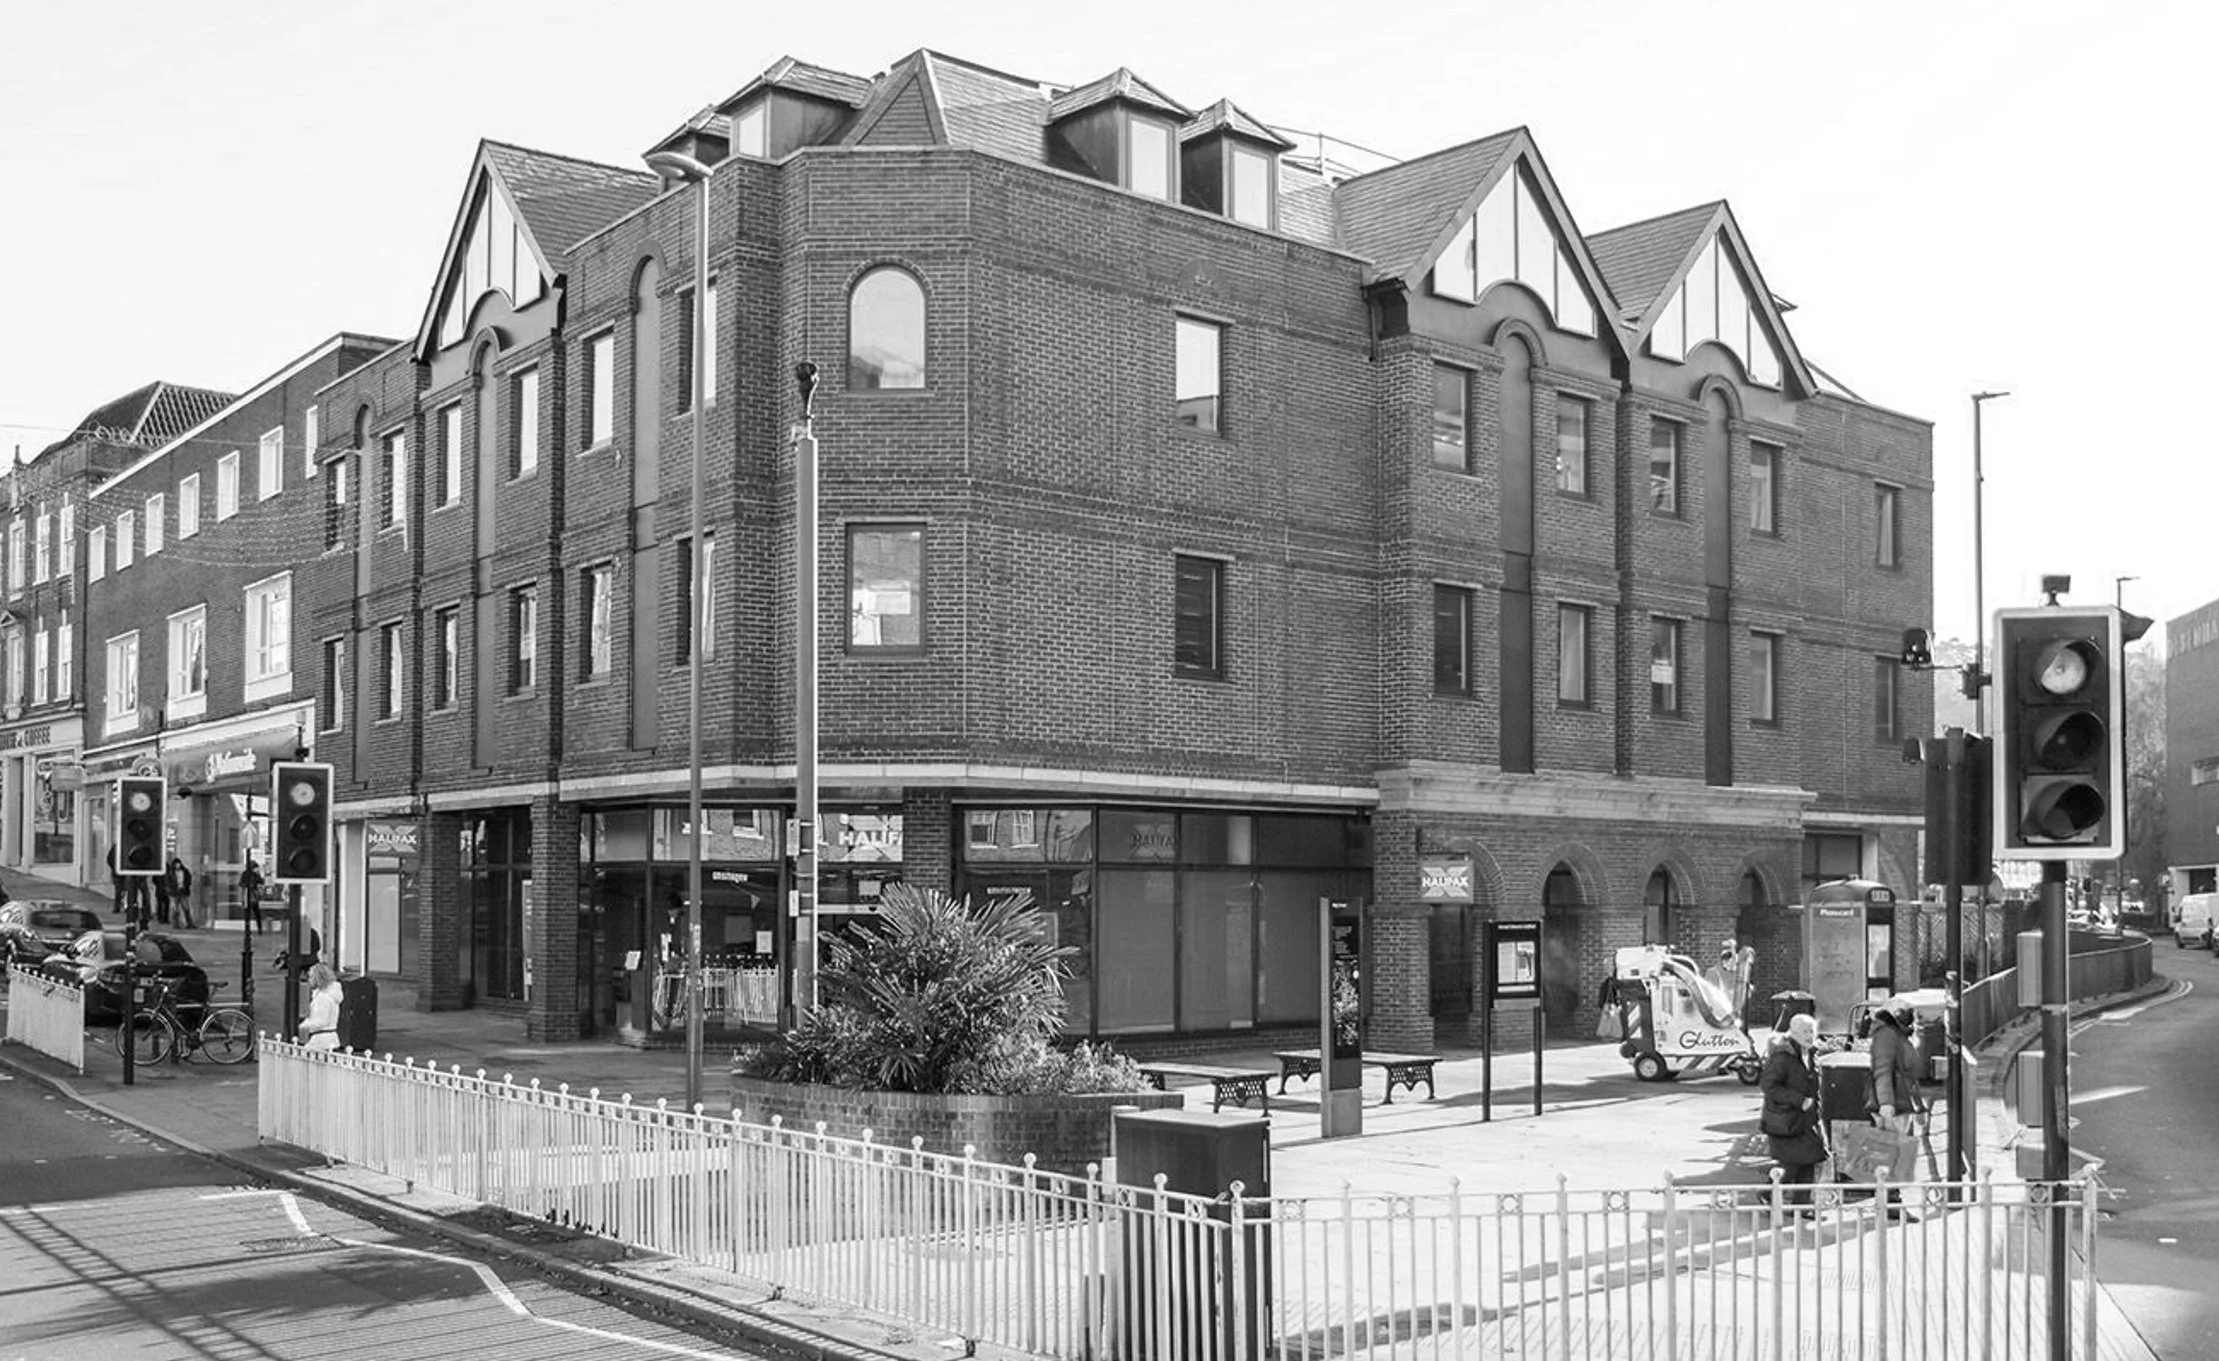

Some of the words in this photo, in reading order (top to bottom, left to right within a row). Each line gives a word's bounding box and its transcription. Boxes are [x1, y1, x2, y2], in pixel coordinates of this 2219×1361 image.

[368, 833, 418, 845] HALIFAX
[838, 830, 903, 848] HALIF
[1421, 876, 1470, 888] HALIFAX
[1679, 1030, 1740, 1050] Glutton
